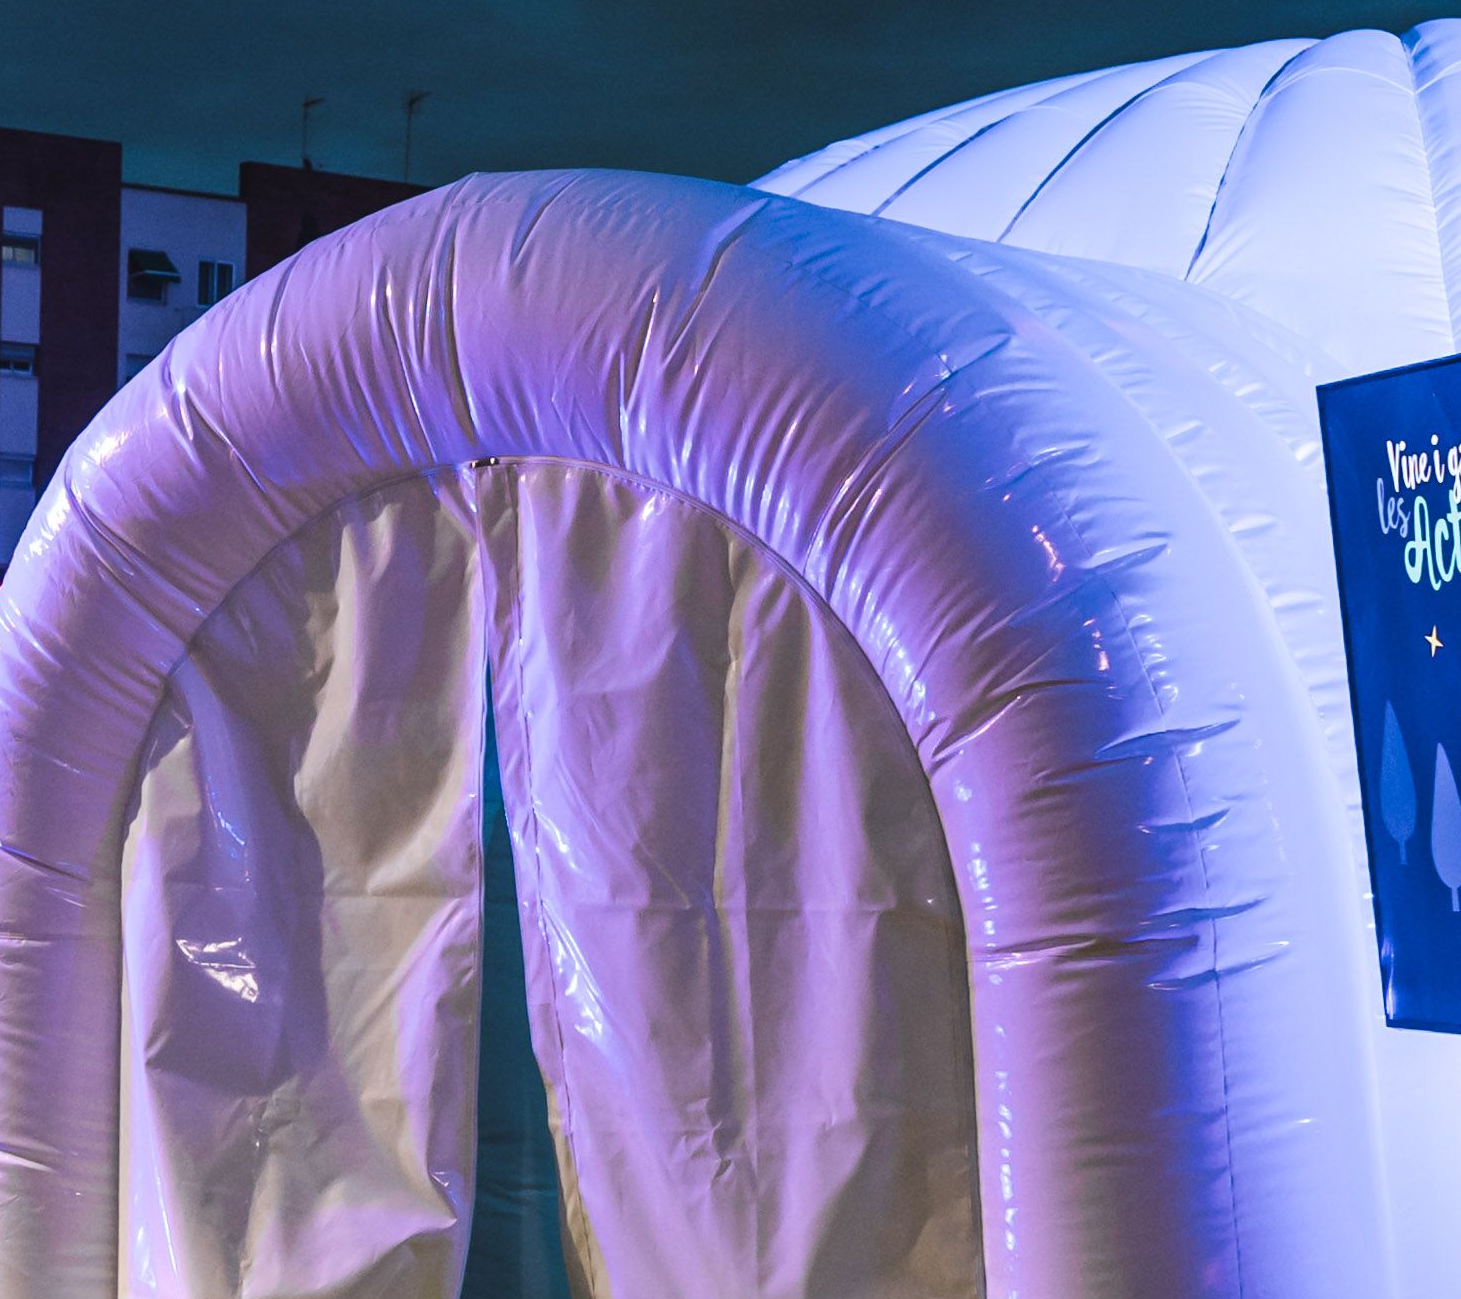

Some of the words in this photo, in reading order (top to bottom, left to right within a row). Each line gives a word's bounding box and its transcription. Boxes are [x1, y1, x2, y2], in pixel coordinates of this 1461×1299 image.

[1386, 440, 1431, 492] Vine
[1430, 434, 1446, 483] i
[1376, 477, 1412, 538] les
